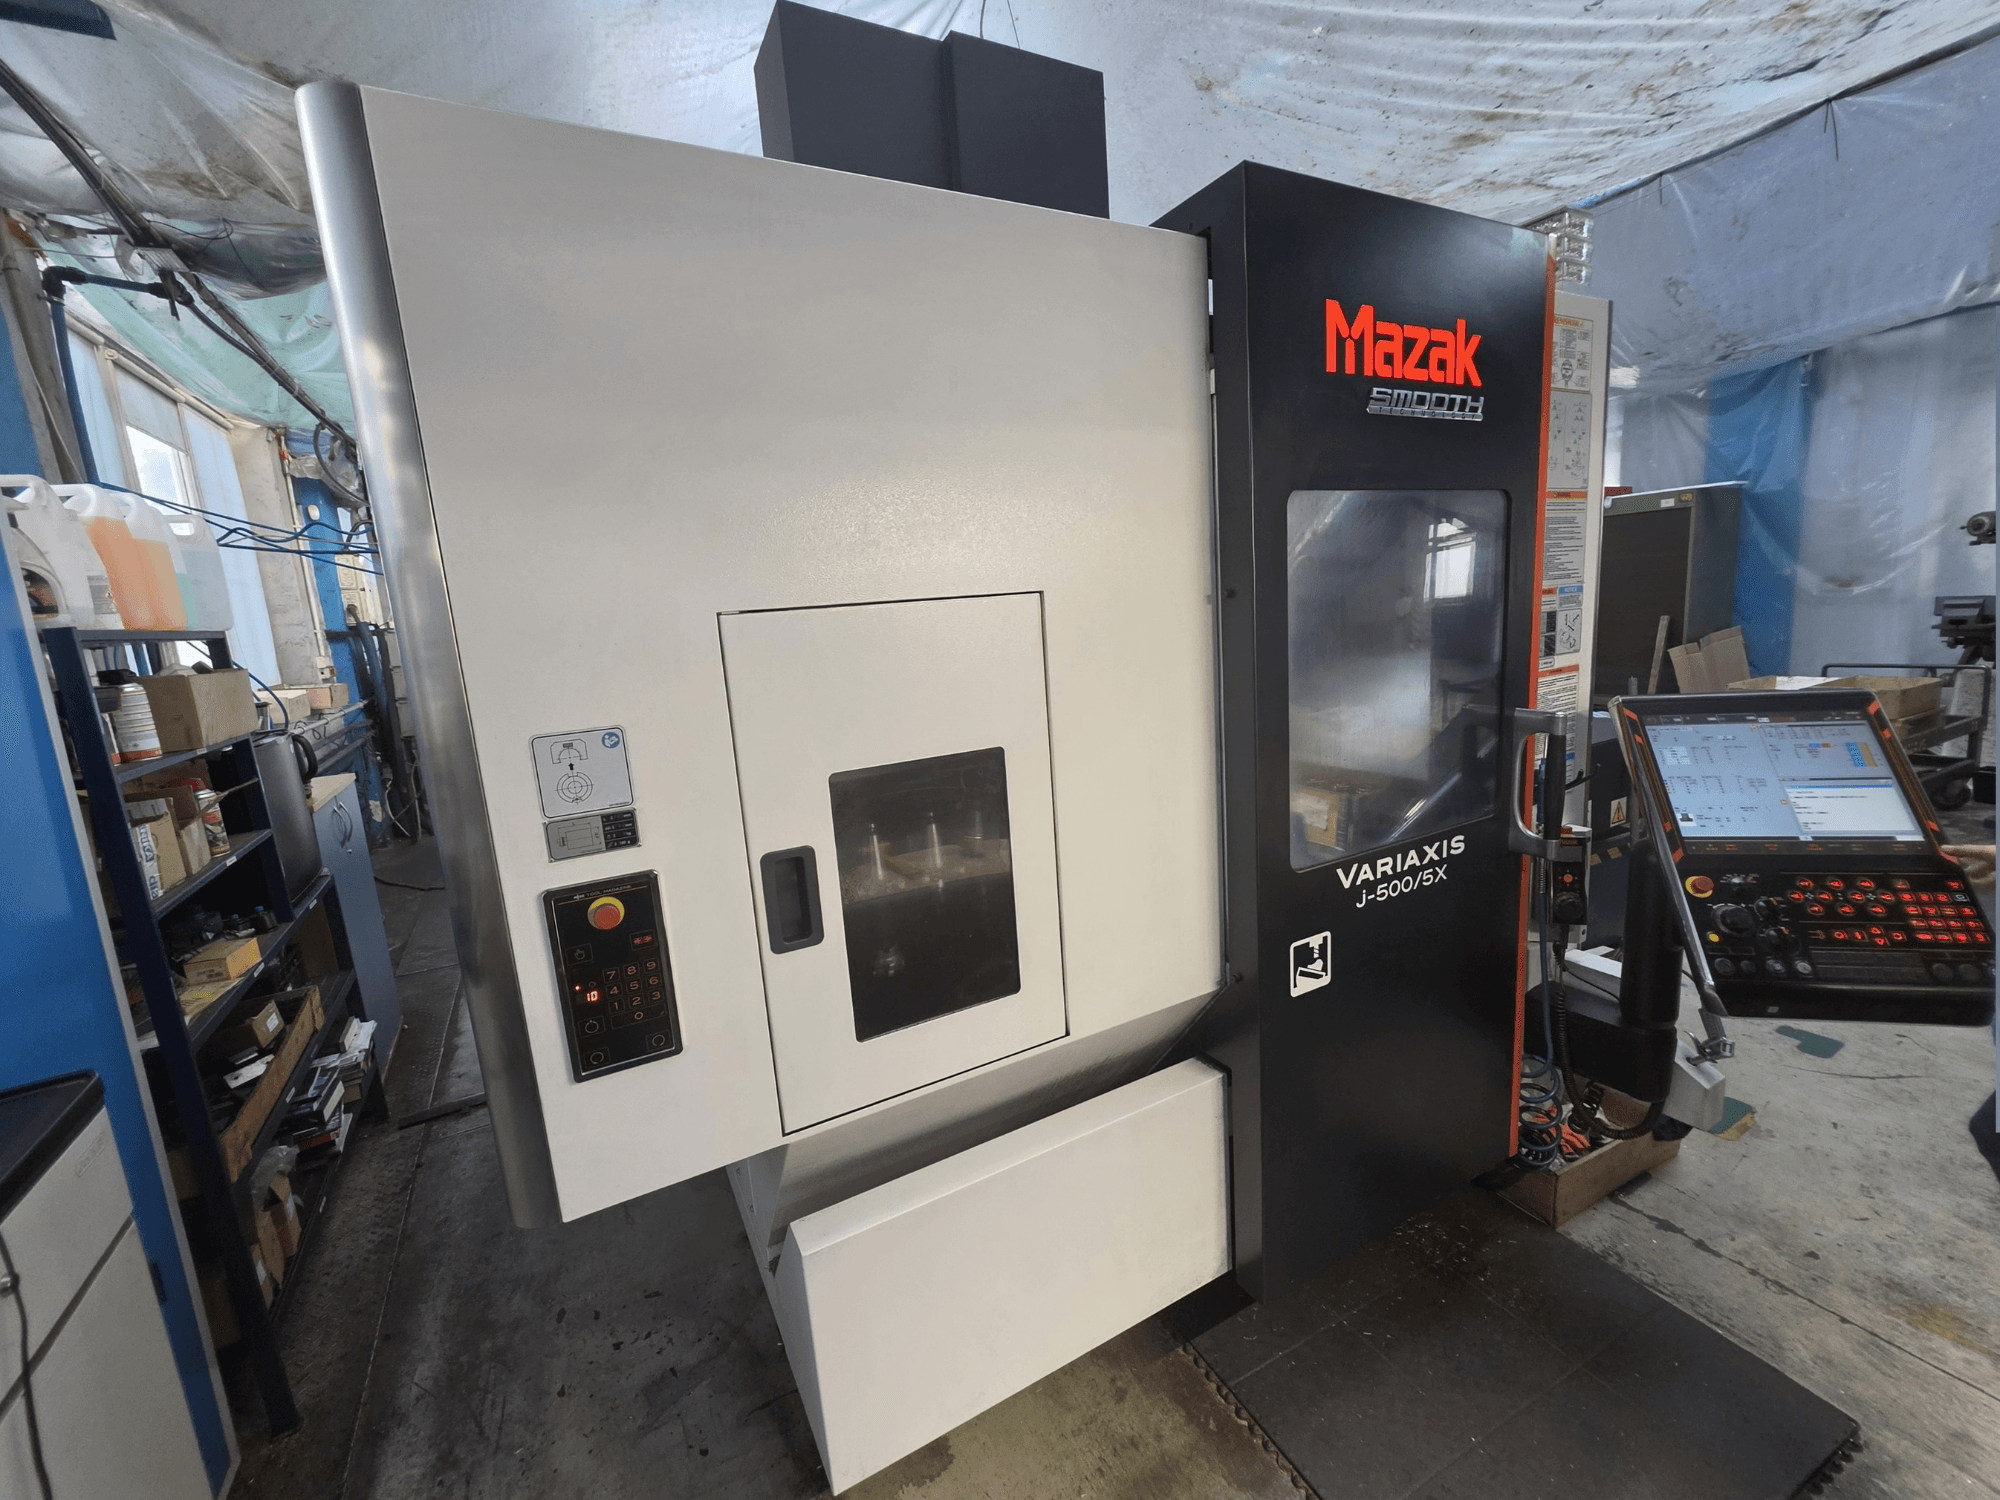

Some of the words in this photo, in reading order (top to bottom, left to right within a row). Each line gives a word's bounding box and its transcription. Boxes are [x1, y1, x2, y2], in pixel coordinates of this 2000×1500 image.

[1325, 298, 1483, 387] Mazak
[1368, 387, 1485, 413] SMOOTH
[1378, 406, 1476, 420] TECHNOLOGY
[1336, 834, 1465, 889] VARIAXIS
[586, 890, 601, 898] TOOL
[1355, 863, 1447, 908] j-500/5X
[606, 970, 616, 980] 7
[627, 965, 637, 975] 8
[646, 961, 656, 970] 9
[609, 986, 619, 995] 4
[630, 981, 639, 990] 5
[649, 976, 659, 985] 6
[586, 990, 598, 1002] 10
[613, 1002, 619, 1010] 1
[632, 996, 641, 1006] 2
[652, 991, 661, 1000] 3
[634, 1011, 643, 1020] 0
